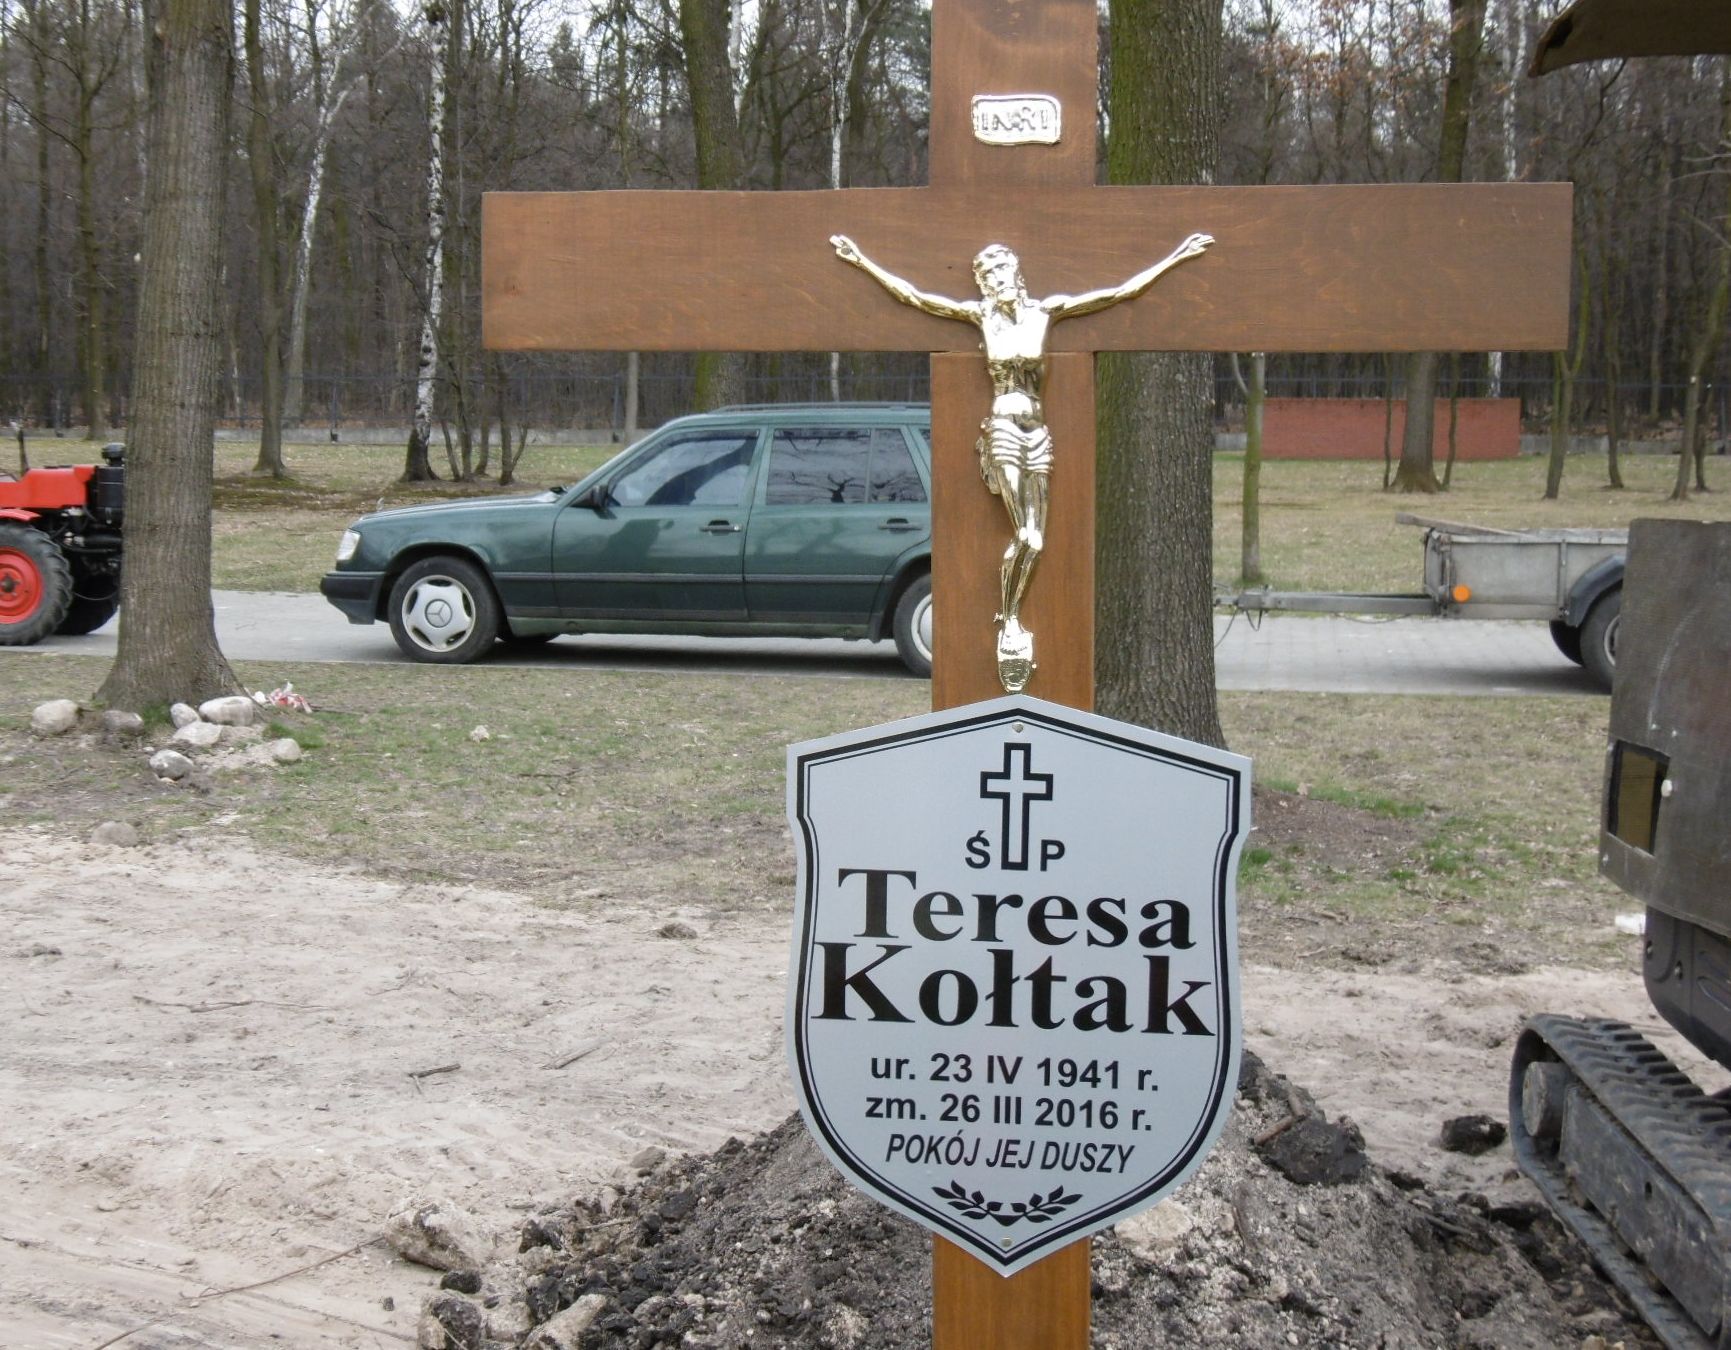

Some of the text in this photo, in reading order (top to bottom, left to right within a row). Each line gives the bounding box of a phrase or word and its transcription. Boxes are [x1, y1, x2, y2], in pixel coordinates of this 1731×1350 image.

[964, 829, 1066, 872] Ś P
[838, 868, 1197, 950] Teresa
[810, 941, 1216, 1036] Kołtak
[871, 1052, 1159, 1092] ur. 23 IV 1941 r.
[865, 1093, 1152, 1132] zm. 26 III 2016 r.
[885, 1129, 1136, 1174] POKÓJ JEJ DUSZY
